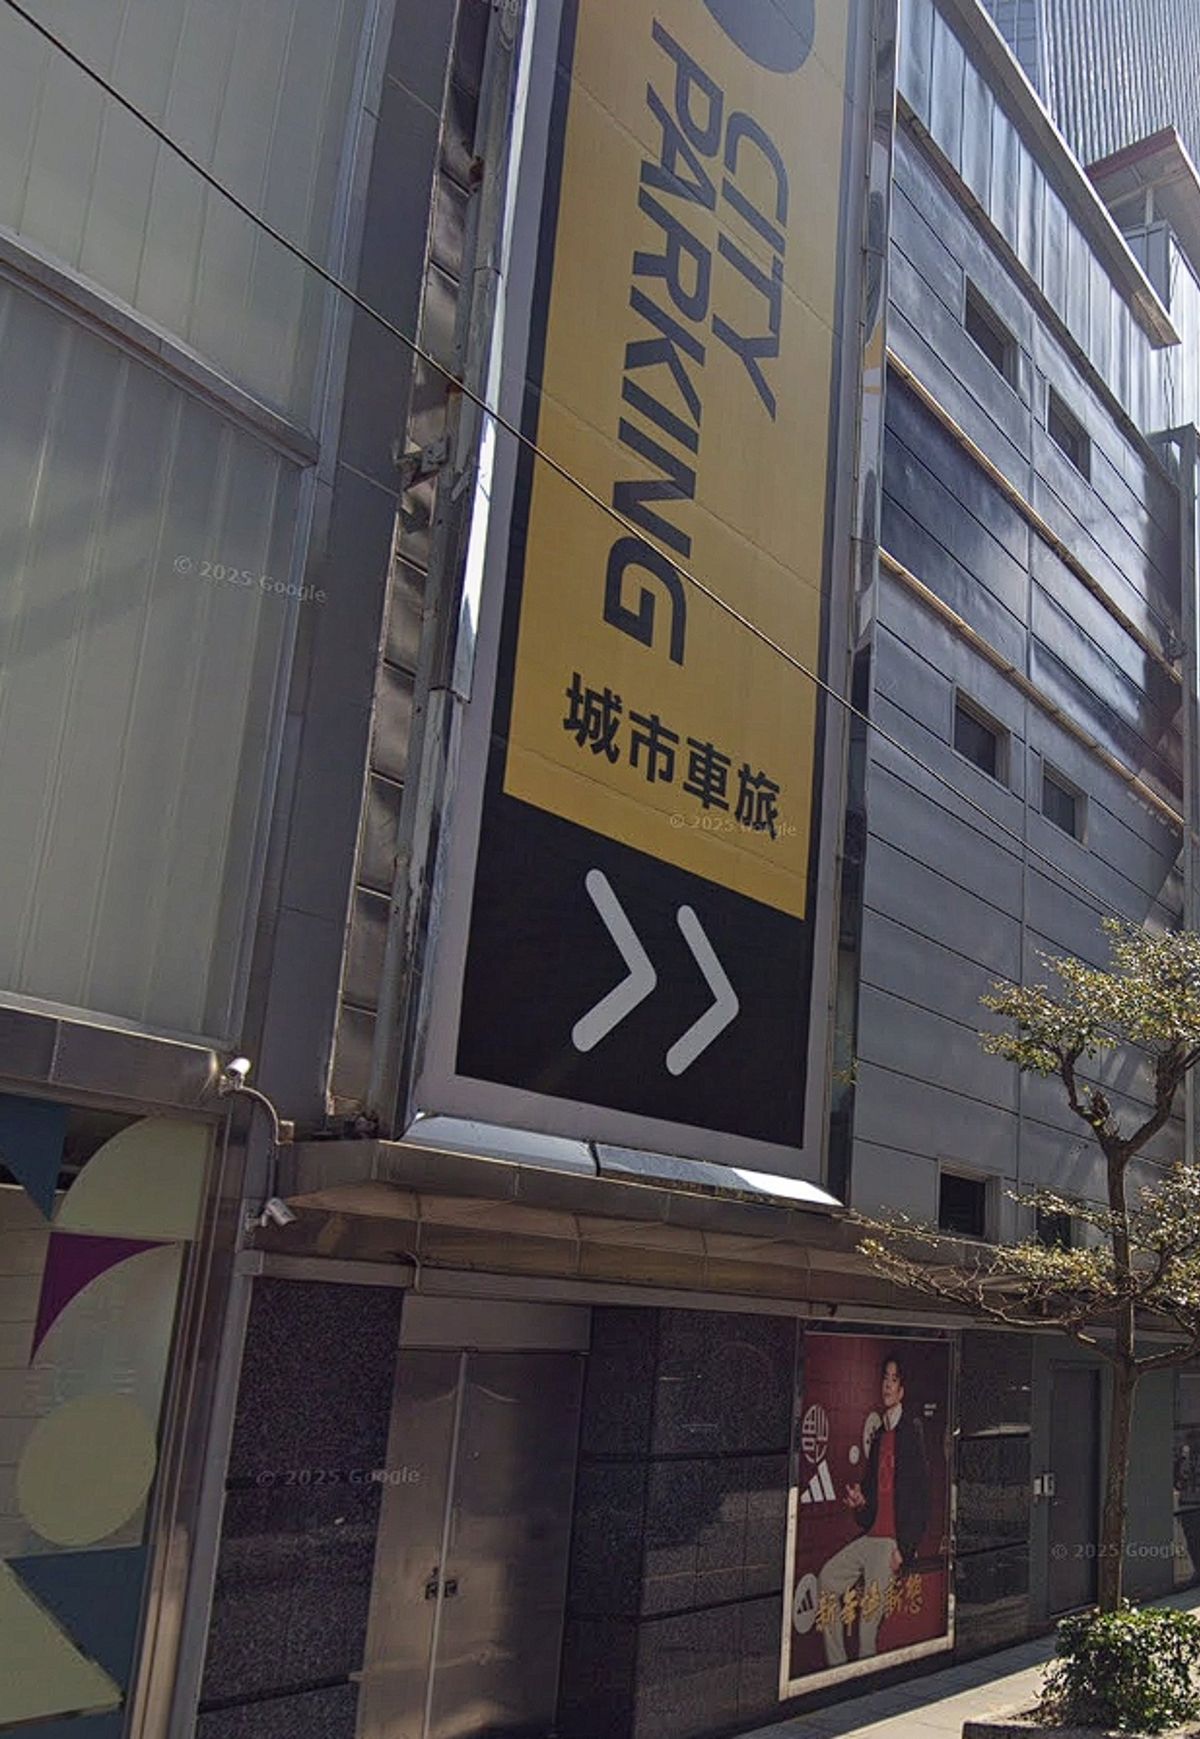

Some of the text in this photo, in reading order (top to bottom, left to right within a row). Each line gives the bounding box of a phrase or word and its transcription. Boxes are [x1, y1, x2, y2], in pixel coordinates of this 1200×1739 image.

[603, 17, 724, 667] PARKING
[712, 110, 790, 422] CITY
[563, 672, 783, 841] 城市車旅
